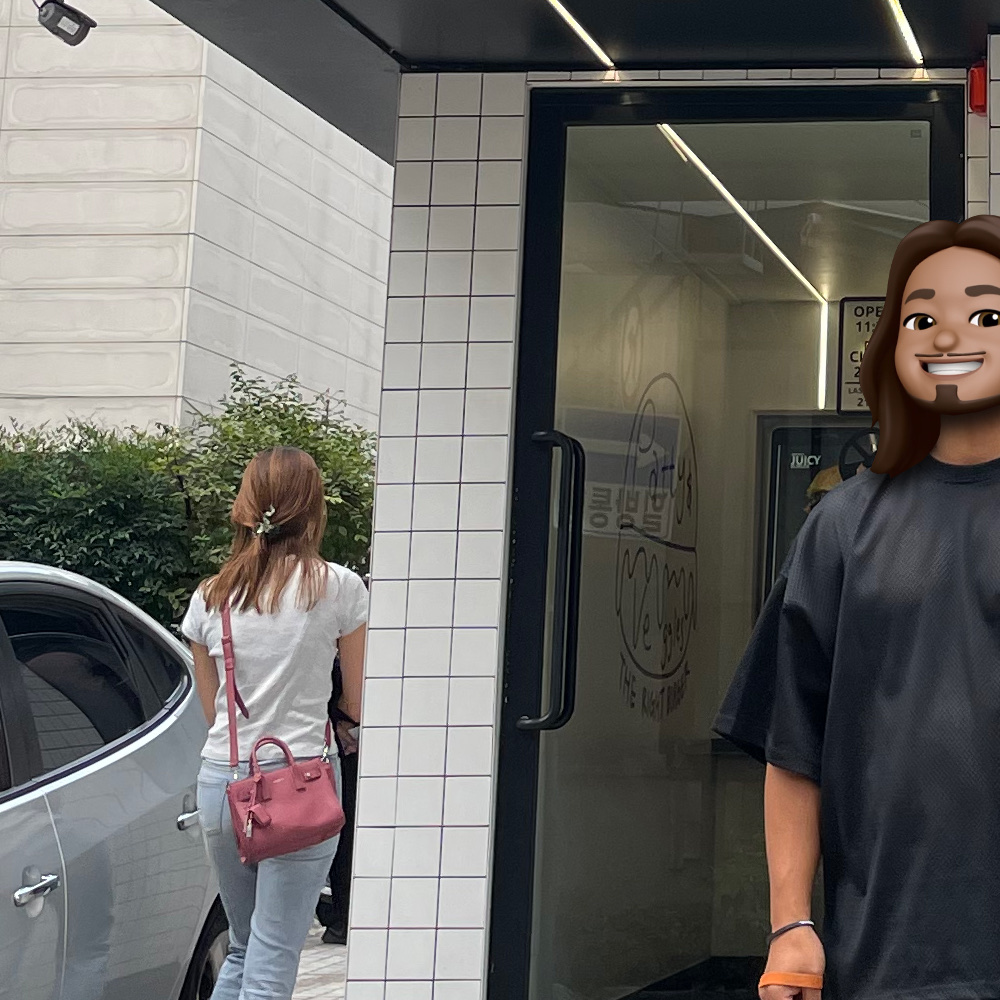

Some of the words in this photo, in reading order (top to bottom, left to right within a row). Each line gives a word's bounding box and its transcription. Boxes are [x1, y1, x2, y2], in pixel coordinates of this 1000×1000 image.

[854, 305, 884, 318] OPE
[847, 387, 864, 395] LAS
[790, 453, 822, 469] JUICY
